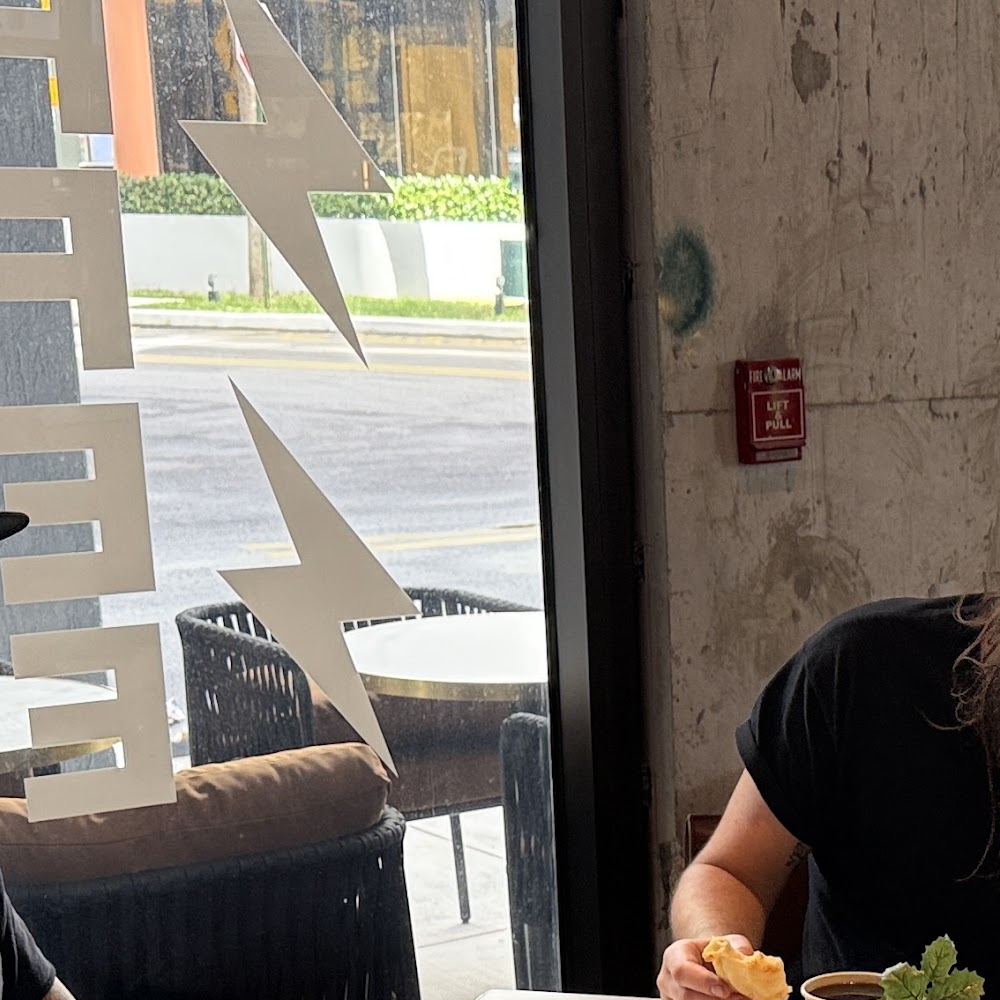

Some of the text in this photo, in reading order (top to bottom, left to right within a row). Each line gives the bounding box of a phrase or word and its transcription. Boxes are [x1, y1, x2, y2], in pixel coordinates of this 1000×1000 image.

[777, 367, 801, 382] LARM
[766, 400, 790, 412] LIFT
[765, 419, 793, 431] PULL
